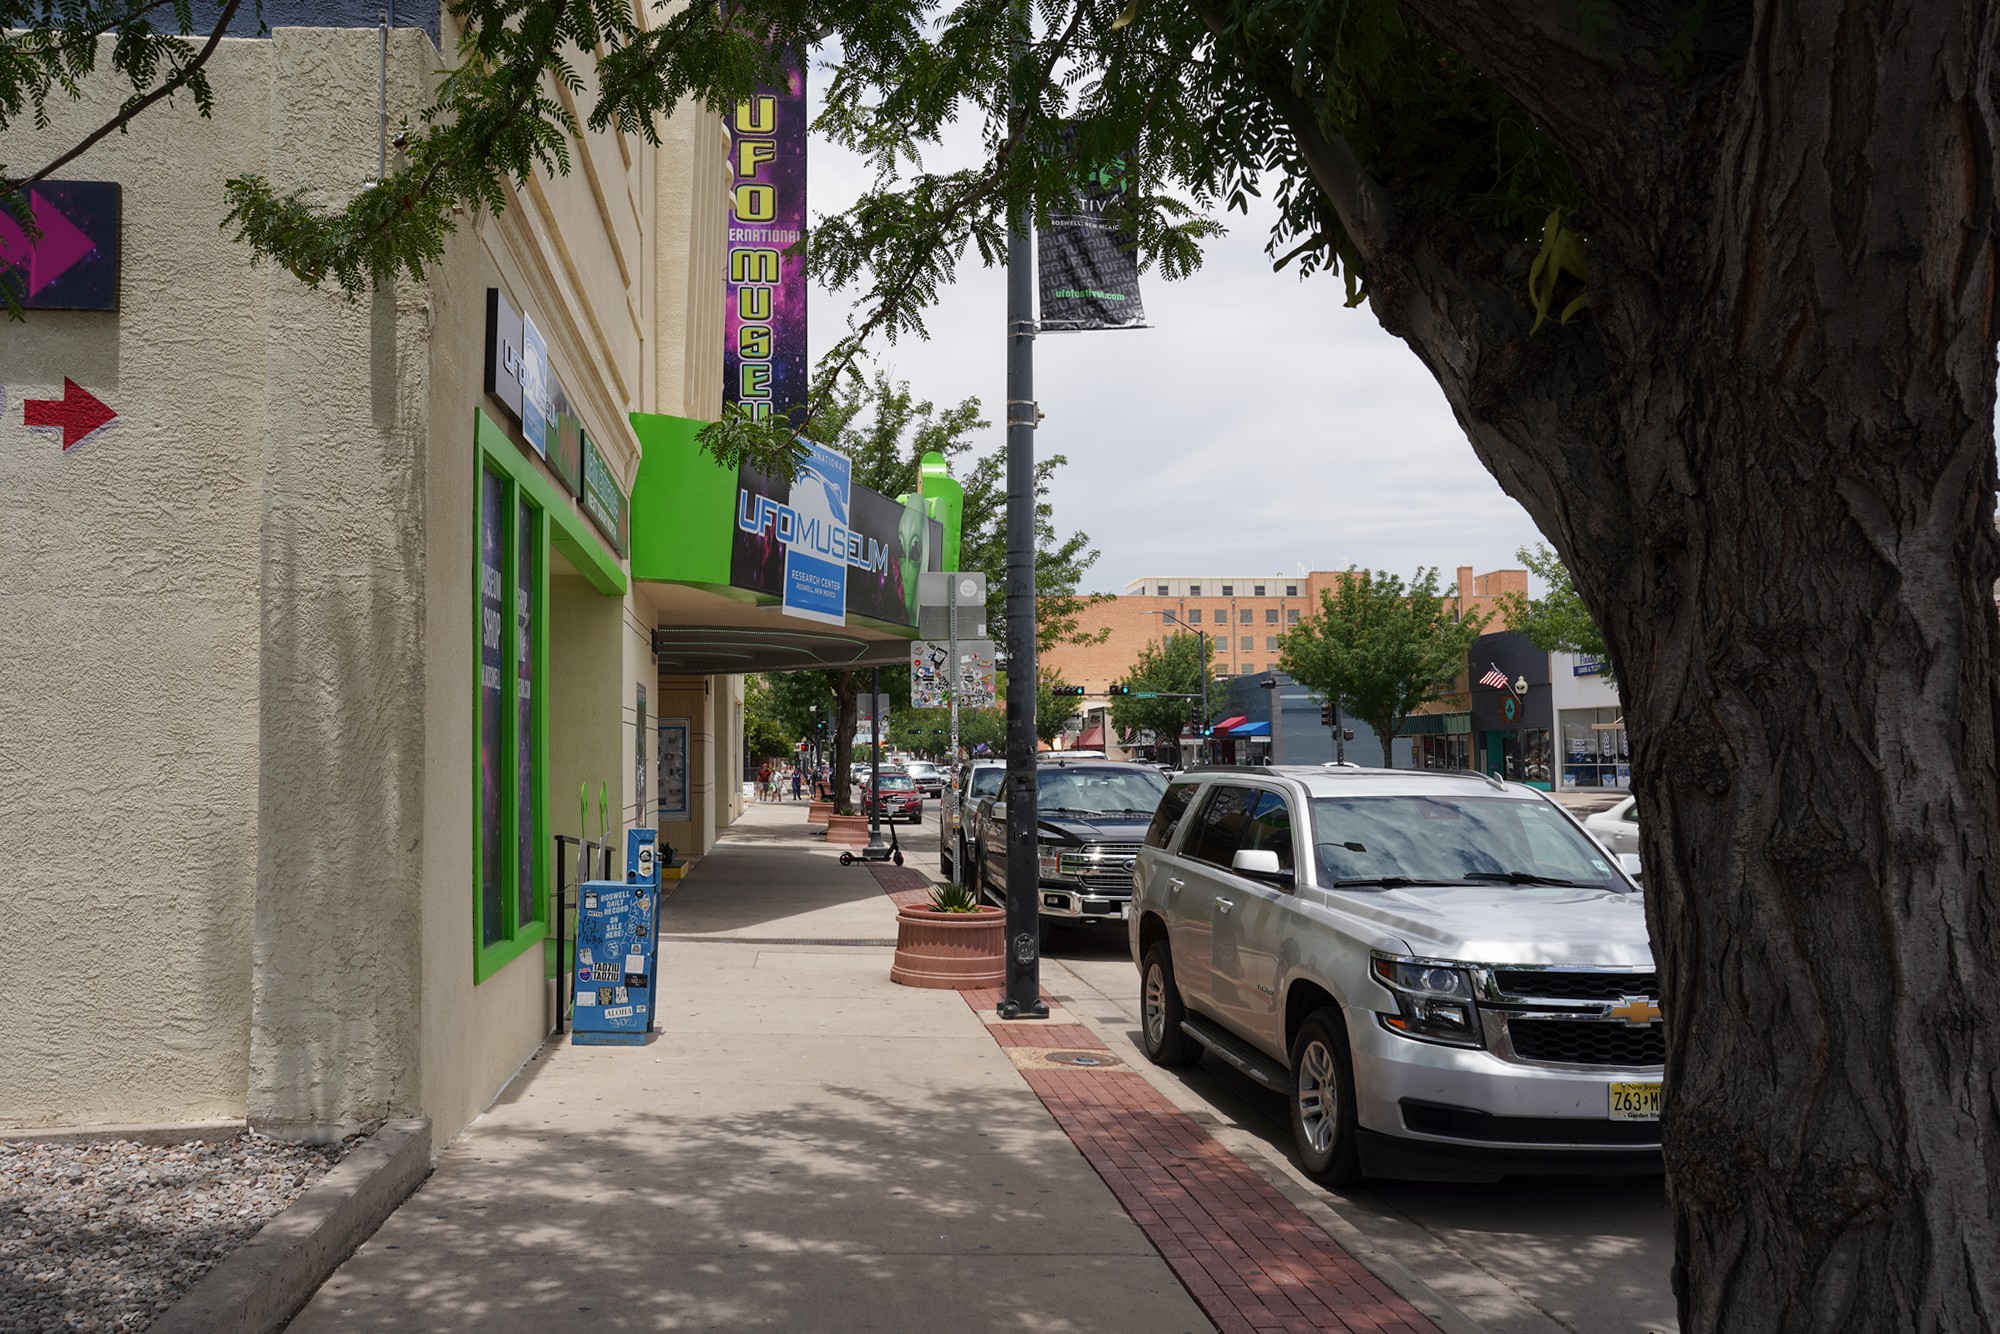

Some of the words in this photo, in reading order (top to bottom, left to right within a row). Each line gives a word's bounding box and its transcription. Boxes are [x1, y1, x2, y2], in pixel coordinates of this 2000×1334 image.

[734, 95, 777, 224] UFO
[791, 569, 820, 586] RESEARCH
[821, 577, 840, 591] CENTER
[814, 587, 823, 595] NEW
[823, 590, 836, 599] MEXICO
[600, 890, 630, 902] ROSWELL
[606, 899, 625, 908] DAILY
[604, 905, 629, 915] RECORD
[606, 922, 622, 931] SALE
[605, 930, 625, 939] HERE!
[594, 962, 620, 972] TADZIU
[593, 971, 619, 981] TADZIU
[606, 1008, 632, 1018] ALOHA
[1614, 1092, 1642, 1112] Z63
